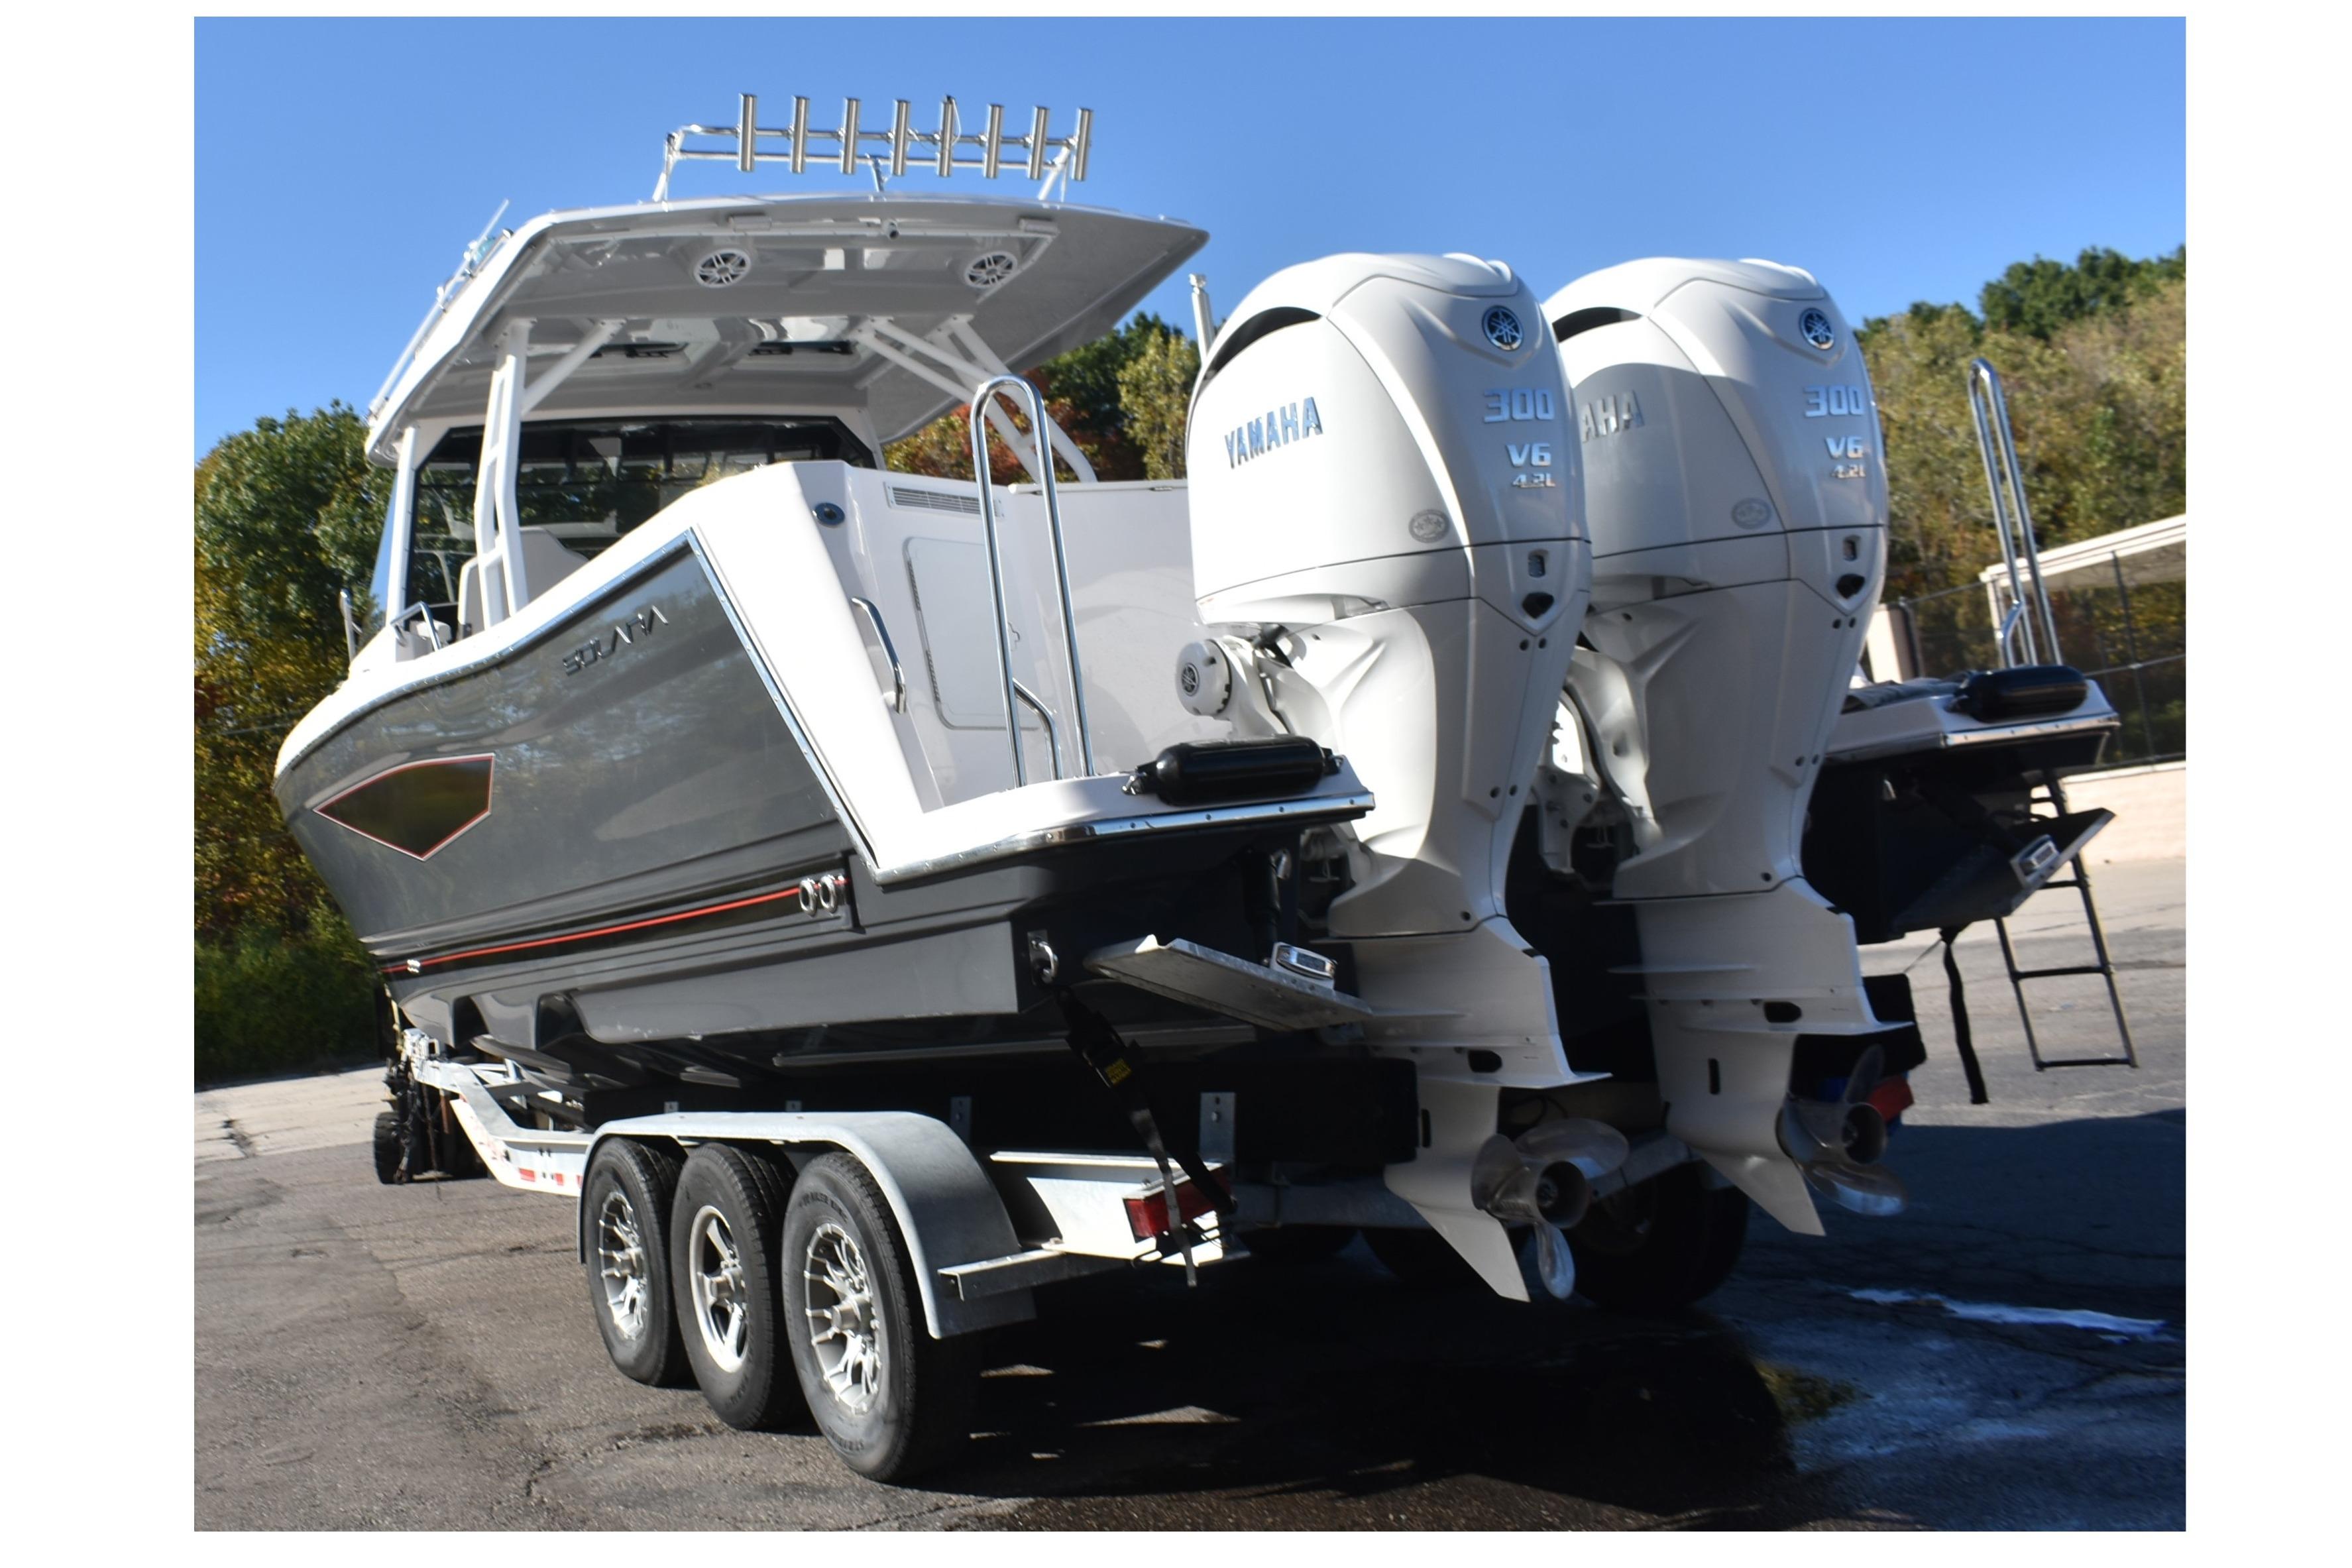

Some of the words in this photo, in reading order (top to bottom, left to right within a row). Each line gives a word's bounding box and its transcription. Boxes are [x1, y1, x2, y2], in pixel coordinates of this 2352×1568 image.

[1483, 388, 1555, 423] 300
[1802, 384, 1865, 417] 300
[1225, 396, 1323, 469] YAMAHA
[1505, 443, 1551, 467] V6
[1824, 436, 1864, 459] V6
[1512, 471, 1556, 488] 4.2L
